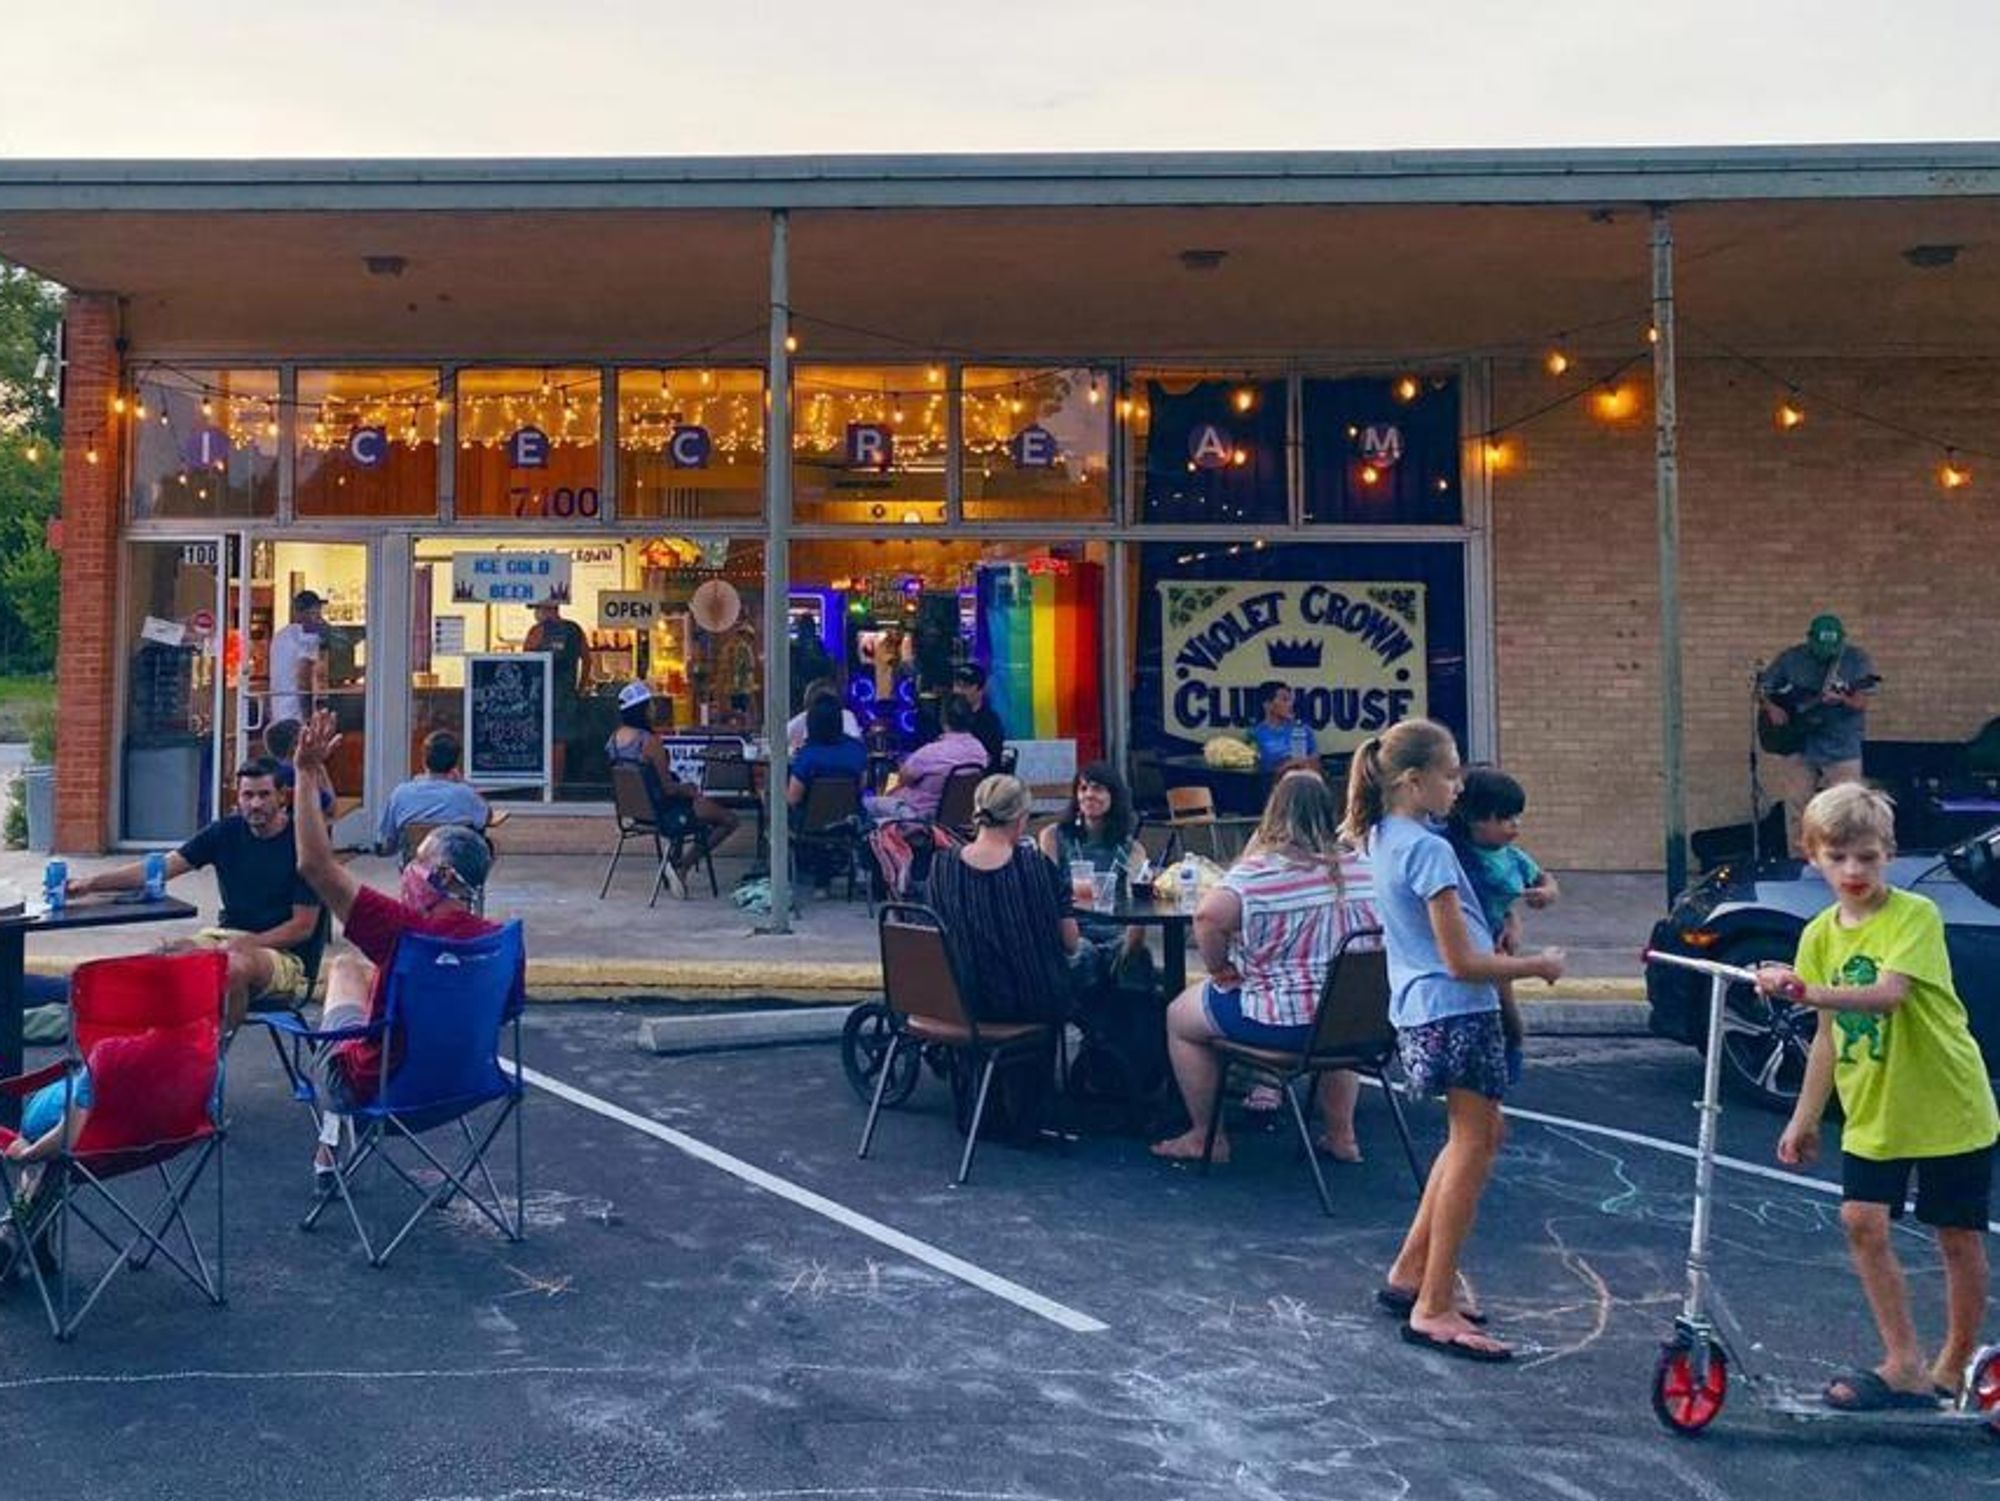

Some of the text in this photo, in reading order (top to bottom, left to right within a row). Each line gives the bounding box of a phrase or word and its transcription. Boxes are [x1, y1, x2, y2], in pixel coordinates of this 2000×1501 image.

[187, 547, 217, 564] 100
[474, 559, 550, 575] ICE COLD
[489, 583, 534, 599] BEER
[604, 601, 653, 617] OPEN
[1175, 584, 1413, 671] VIOLET CROWN
[1173, 680, 1415, 732] CLUOUSE
